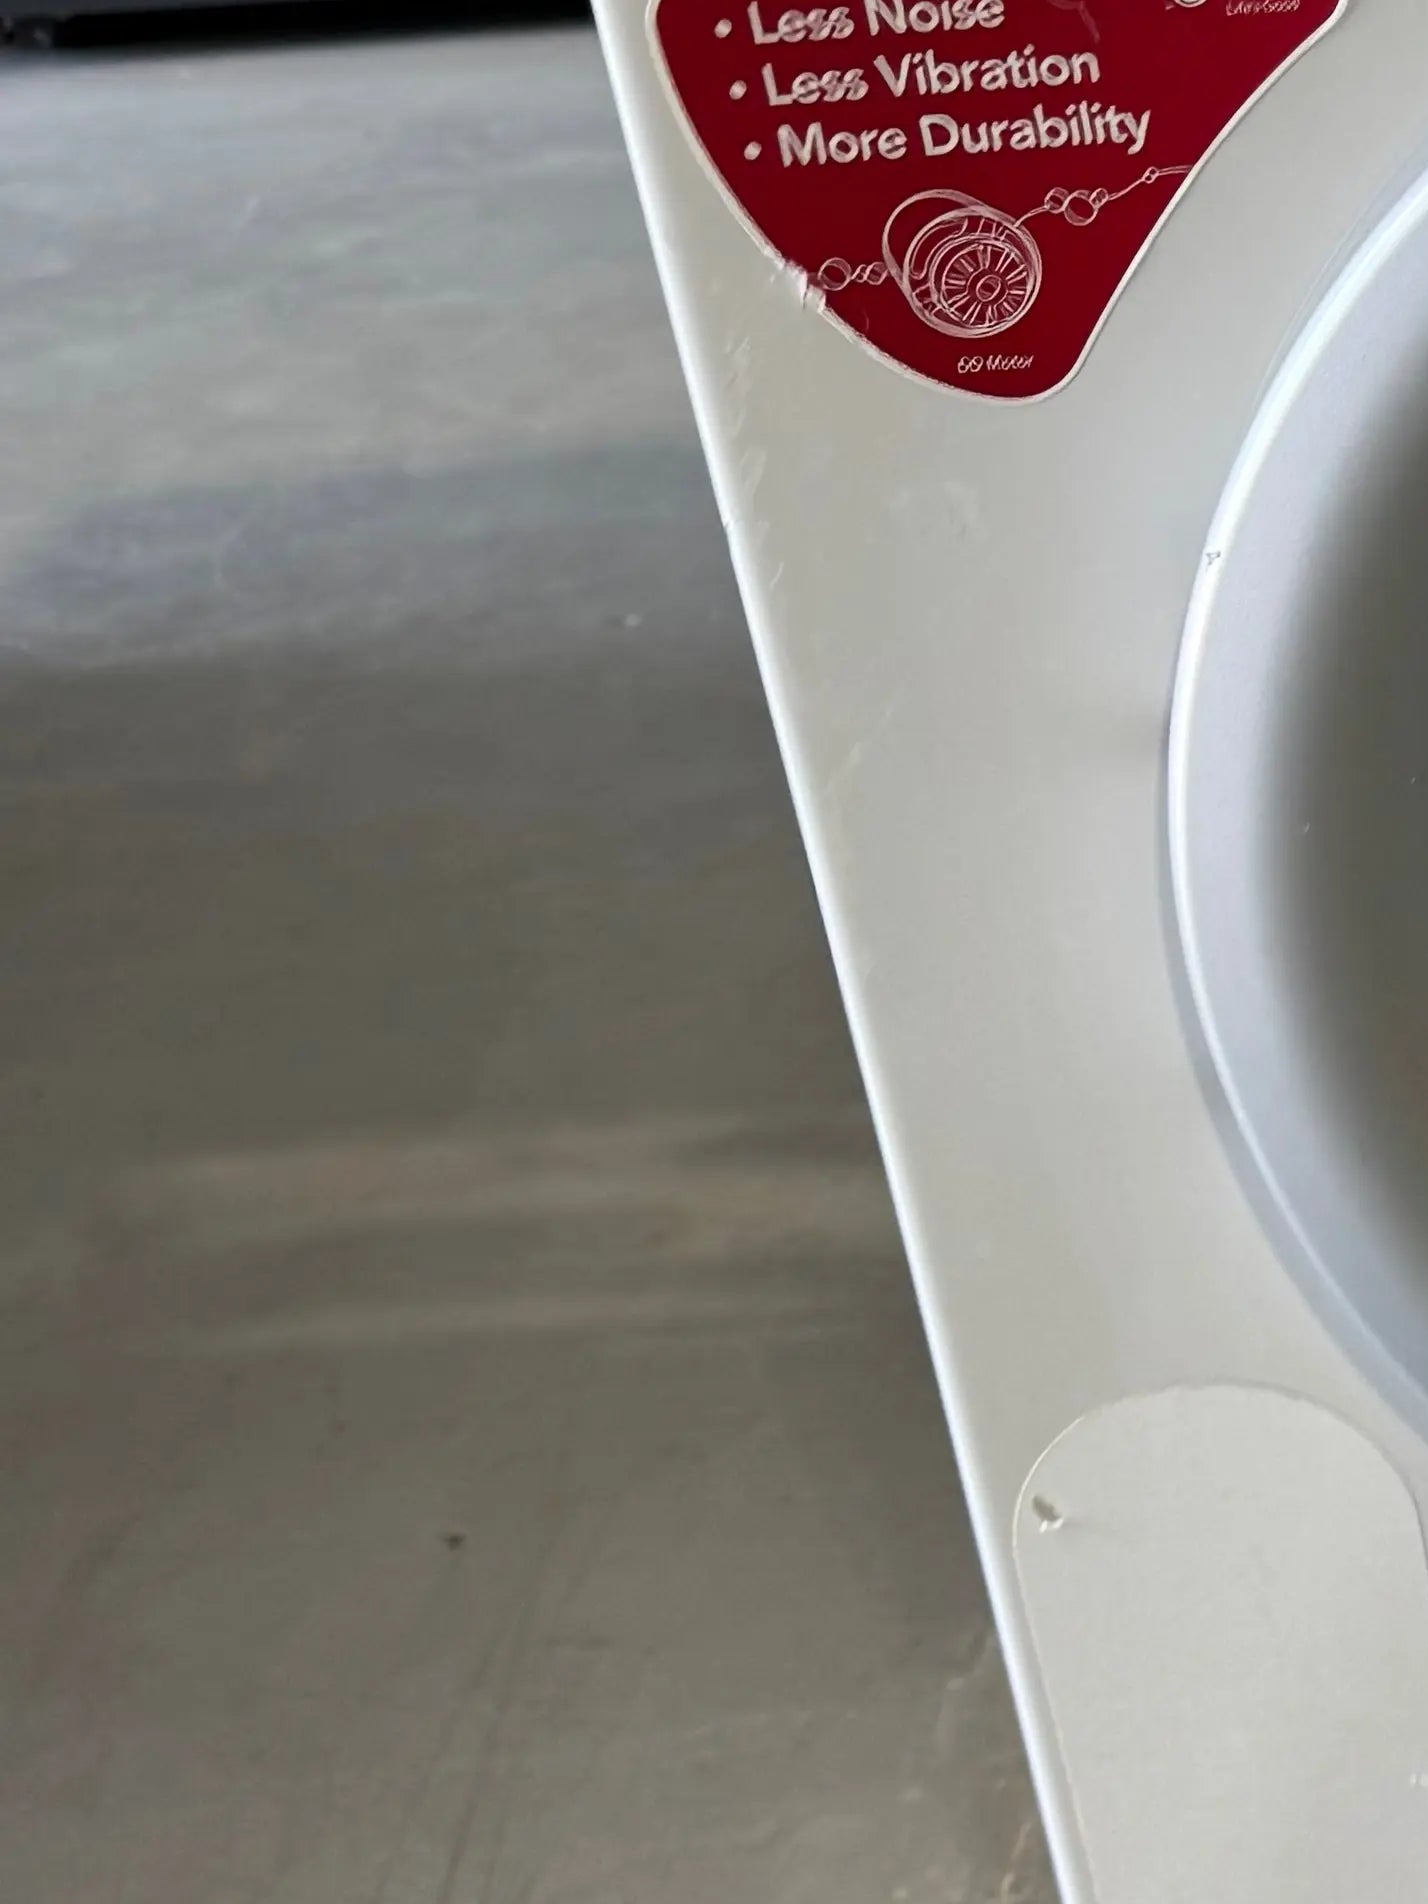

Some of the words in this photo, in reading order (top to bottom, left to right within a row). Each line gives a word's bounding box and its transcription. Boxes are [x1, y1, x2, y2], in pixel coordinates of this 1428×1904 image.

[747, 0, 856, 45] Less
[761, 62, 869, 107] Less
[873, 44, 1101, 98] Vibration
[776, 121, 908, 168] More
[918, 100, 1152, 156] Durability
